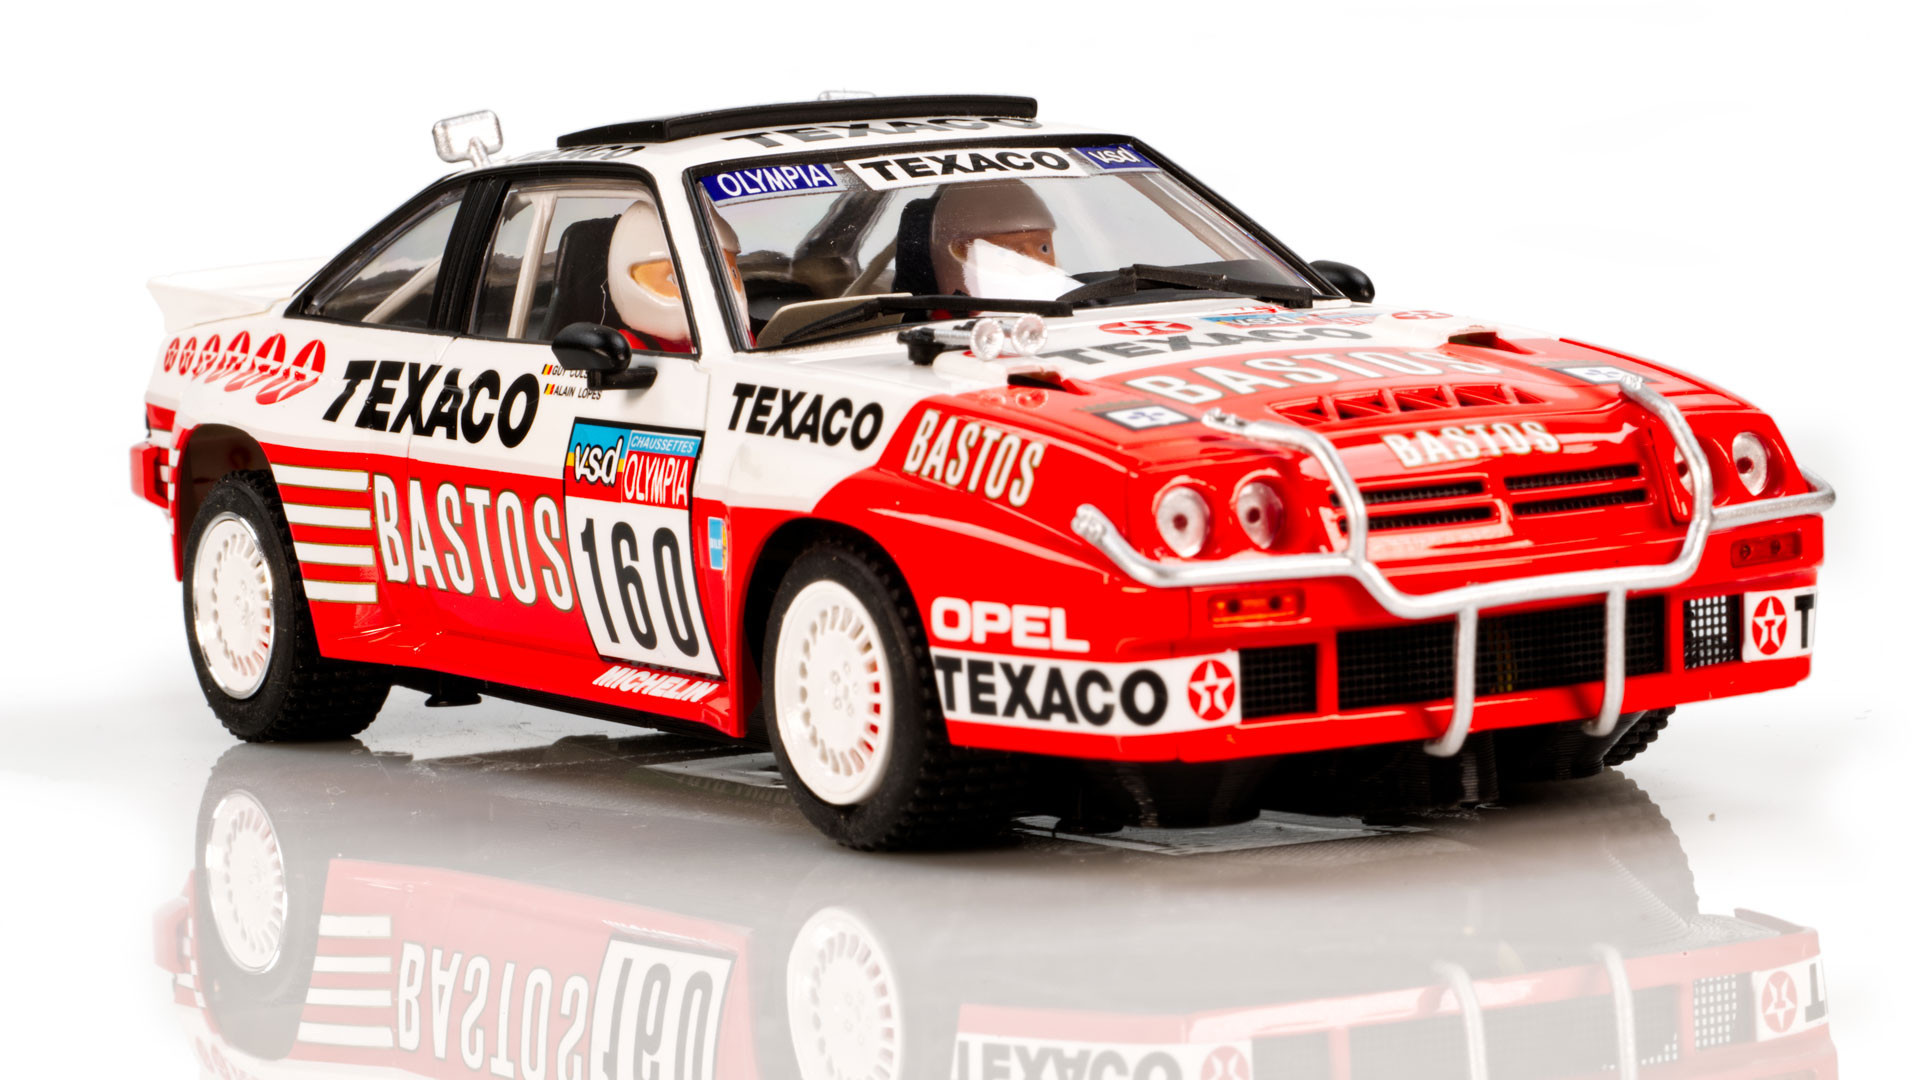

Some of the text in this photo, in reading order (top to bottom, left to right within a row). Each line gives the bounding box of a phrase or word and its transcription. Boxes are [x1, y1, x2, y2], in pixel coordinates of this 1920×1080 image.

[717, 164, 834, 197] OLYMPIA
[858, 149, 1071, 182] TEXACO
[1087, 146, 1142, 164] vsd
[1036, 327, 1373, 366] TEXACO
[554, 385, 576, 397] ALAIN
[1125, 350, 1502, 404] BASTOS
[323, 360, 540, 449] TEXACO
[728, 383, 883, 451] TEXACO
[573, 434, 625, 487] vsd
[631, 435, 695, 454] CHAUSSETTES
[902, 408, 1046, 508] BASTOS
[1380, 418, 1562, 469] BASTOS
[624, 453, 689, 507] OLYMPIA
[373, 472, 575, 612] BASTOS
[580, 517, 701, 658] 160
[930, 596, 1090, 653] OPEL
[592, 665, 719, 702] MICHELIN
[934, 654, 1168, 727] TEXACO
